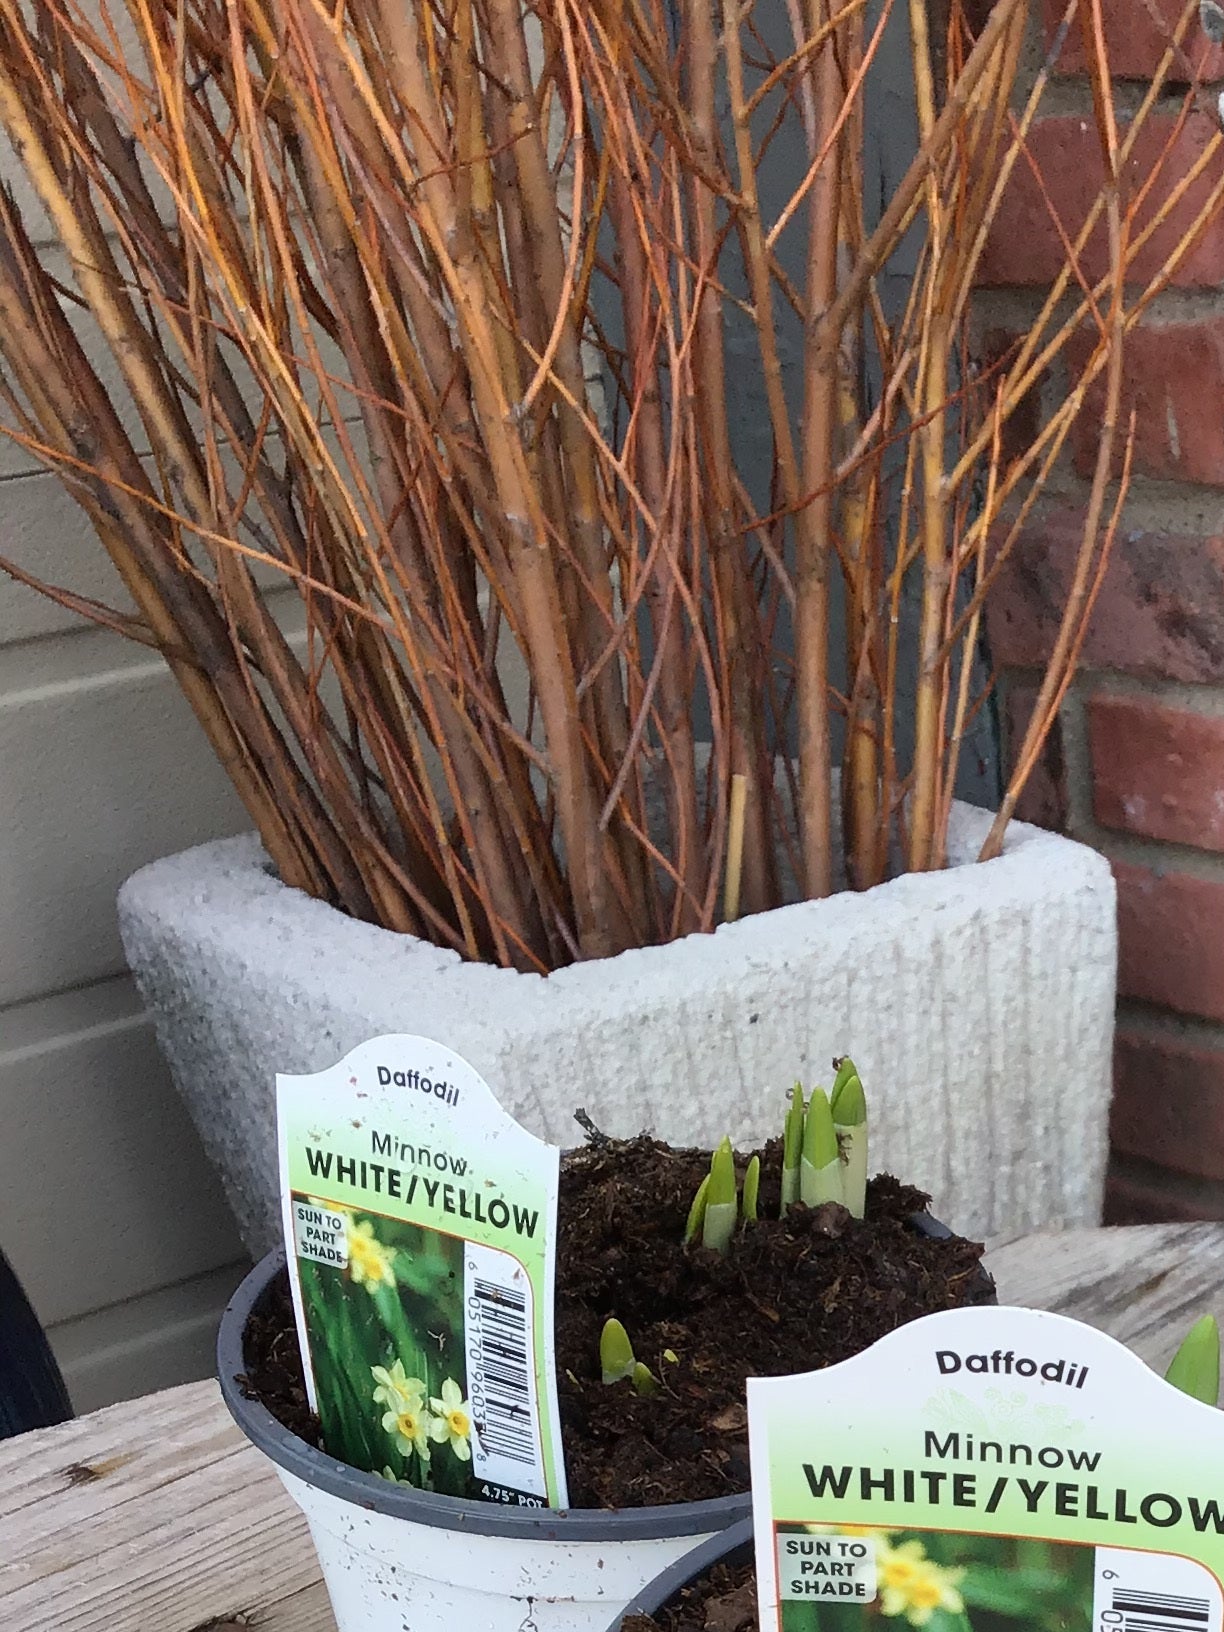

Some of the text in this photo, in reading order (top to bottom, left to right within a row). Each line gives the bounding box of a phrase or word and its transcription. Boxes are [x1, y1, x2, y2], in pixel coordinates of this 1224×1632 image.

[377, 1066, 460, 1106] Daffodil
[371, 1130, 467, 1177] Minnow
[305, 1146, 539, 1239] WHITE/YELLOW
[297, 1208, 342, 1230] SUN TO
[306, 1227, 336, 1245] PART
[301, 1240, 343, 1263] SHADE
[935, 1349, 1090, 1390] Daffodil
[924, 1430, 1102, 1472] Minnow
[785, 1540, 868, 1559] SUN TO
[800, 1561, 855, 1577] PART
[790, 1580, 866, 1598] SHADE
